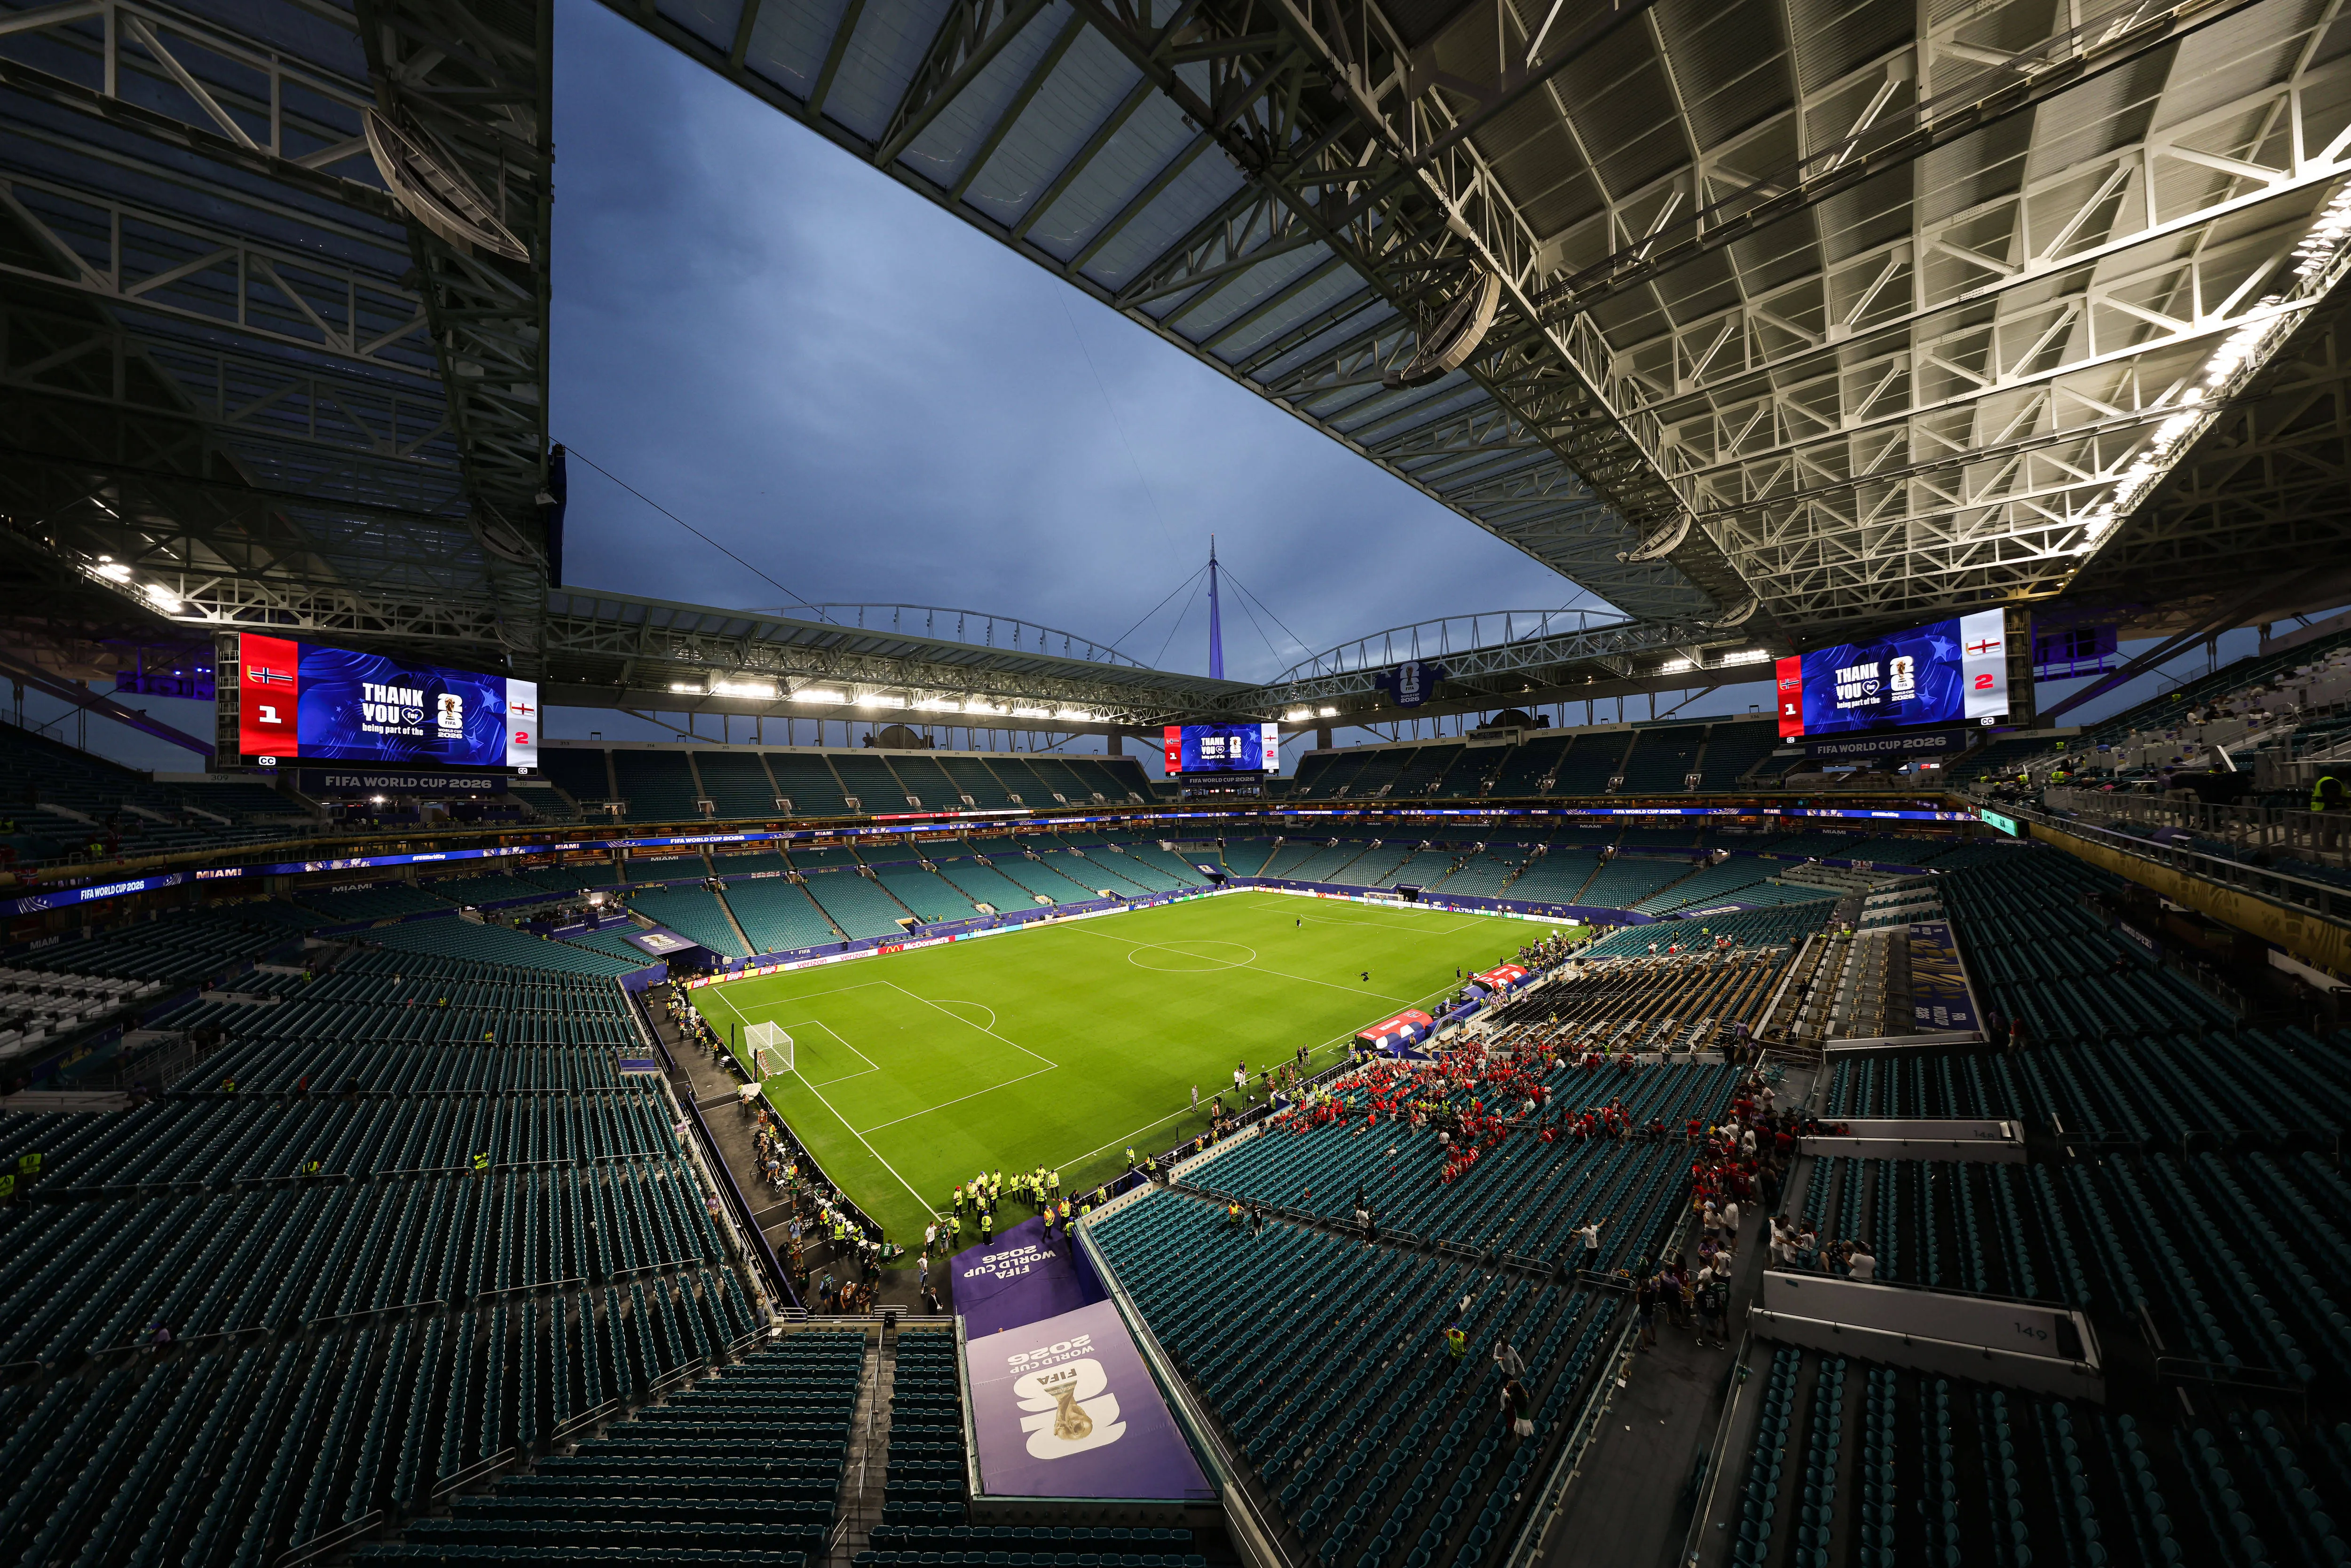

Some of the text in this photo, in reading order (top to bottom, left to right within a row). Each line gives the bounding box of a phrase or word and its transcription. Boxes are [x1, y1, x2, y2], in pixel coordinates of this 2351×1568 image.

[1836, 662, 1879, 684] THANK
[1975, 673, 1993, 690] 2
[363, 683, 423, 707] THANK
[1836, 682, 1862, 700] YOU
[1785, 703, 1796, 715] 1
[1852, 699, 1863, 708] part
[259, 706, 282, 724] 1
[363, 703, 399, 724] YOU
[362, 723, 383, 734] being
[515, 732, 529, 744] 2
[1201, 737, 1224, 746] THANK
[1839, 742, 1877, 753] WORLD
[1878, 741, 1901, 750] CUP
[1903, 736, 1946, 748] 2026
[326, 776, 491, 788] FIFA WORLD CUP 2026
[197, 868, 242, 879] MIAMI
[81, 881, 144, 900] FIFA WORLD CUP 2026
[332, 883, 372, 892] MIAMI
[30, 935, 59, 950] MIAMI
[903, 937, 949, 950] McDonald's
[840, 952, 868, 961] verizon
[797, 959, 827, 968] verizon
[727, 971, 743, 981] Lay's
[760, 966, 776, 975] Lay's
[693, 977, 709, 987] Lay's
[1916, 1007, 1930, 1019] 2026
[1933, 1006, 1948, 1018] WORLD
[982, 1245, 1037, 1264] 2026
[964, 1250, 1056, 1277] WORLD CUP
[995, 1265, 1029, 1279] FIFA
[2014, 1322, 2047, 1341] 149
[1007, 1334, 1091, 1365] 2026
[1010, 1345, 1095, 1373] WORLD CUP
[1036, 1368, 1077, 1385] FIFA
